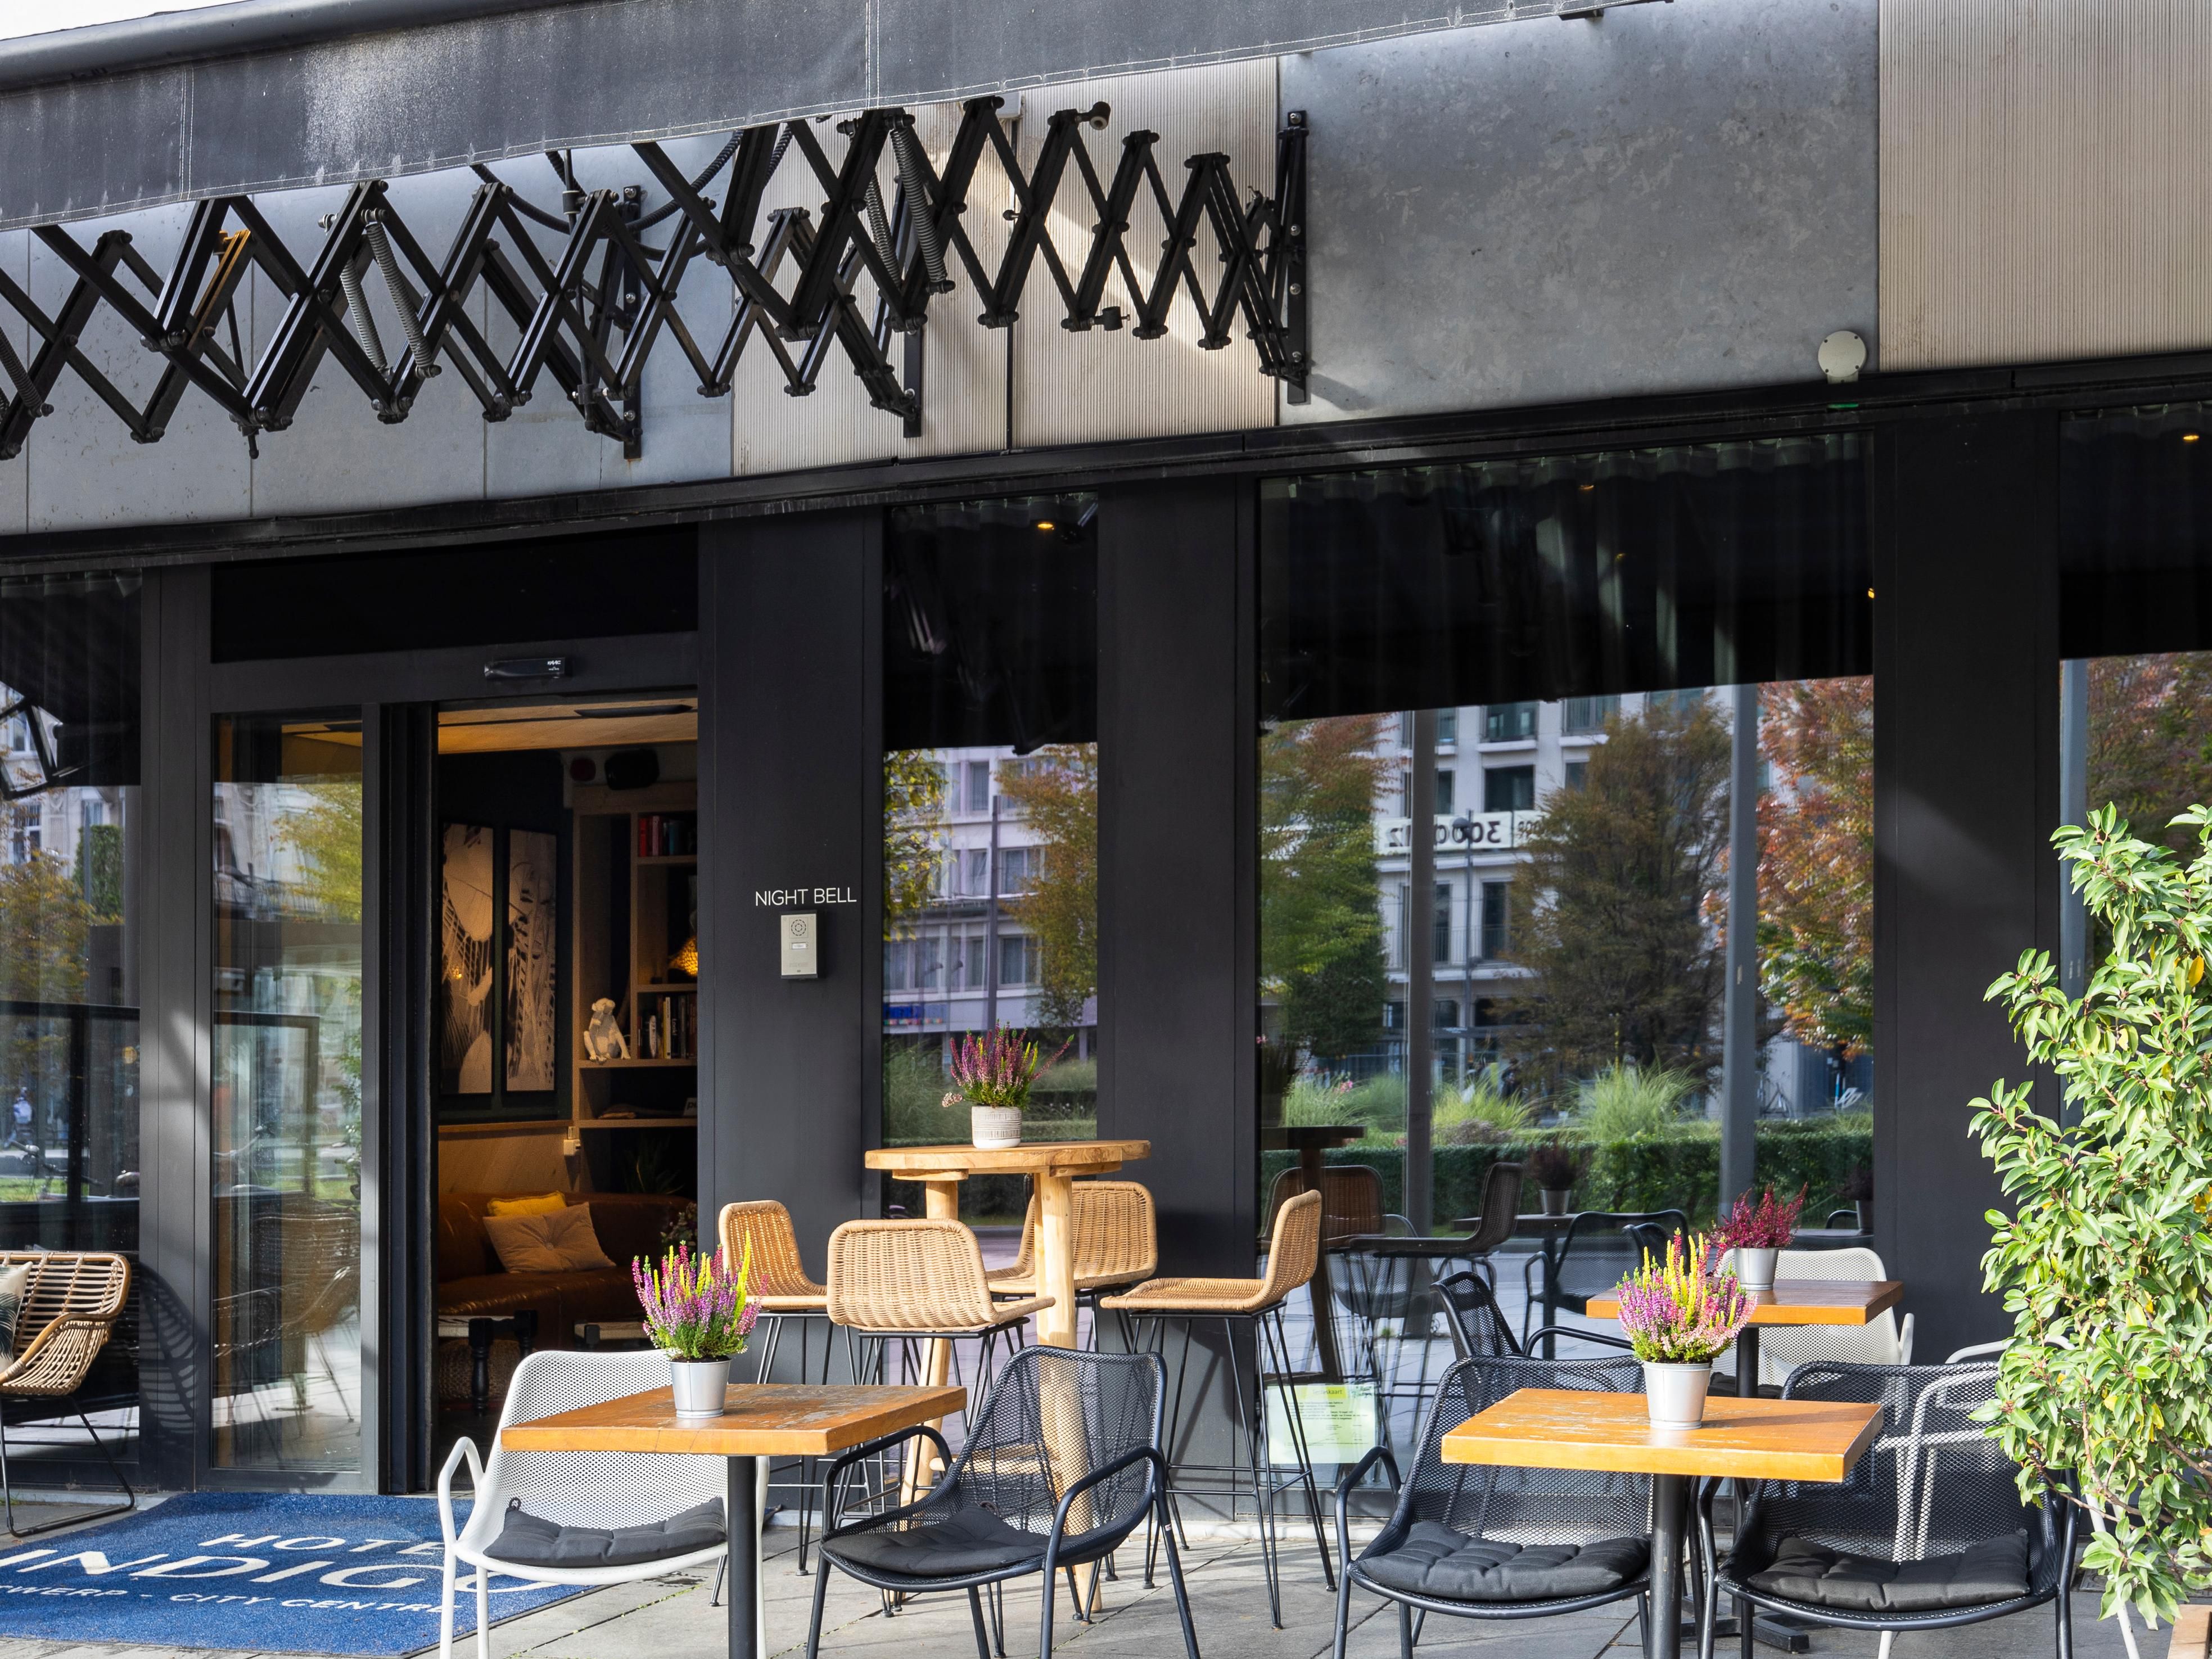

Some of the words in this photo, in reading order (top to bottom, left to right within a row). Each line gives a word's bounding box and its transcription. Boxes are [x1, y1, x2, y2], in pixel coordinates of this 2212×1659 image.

[756, 889, 809, 906] NIGHT
[814, 887, 857, 903] BELL
[197, 1533, 445, 1555] HOTE
[170, 1593, 275, 1604] CITY
